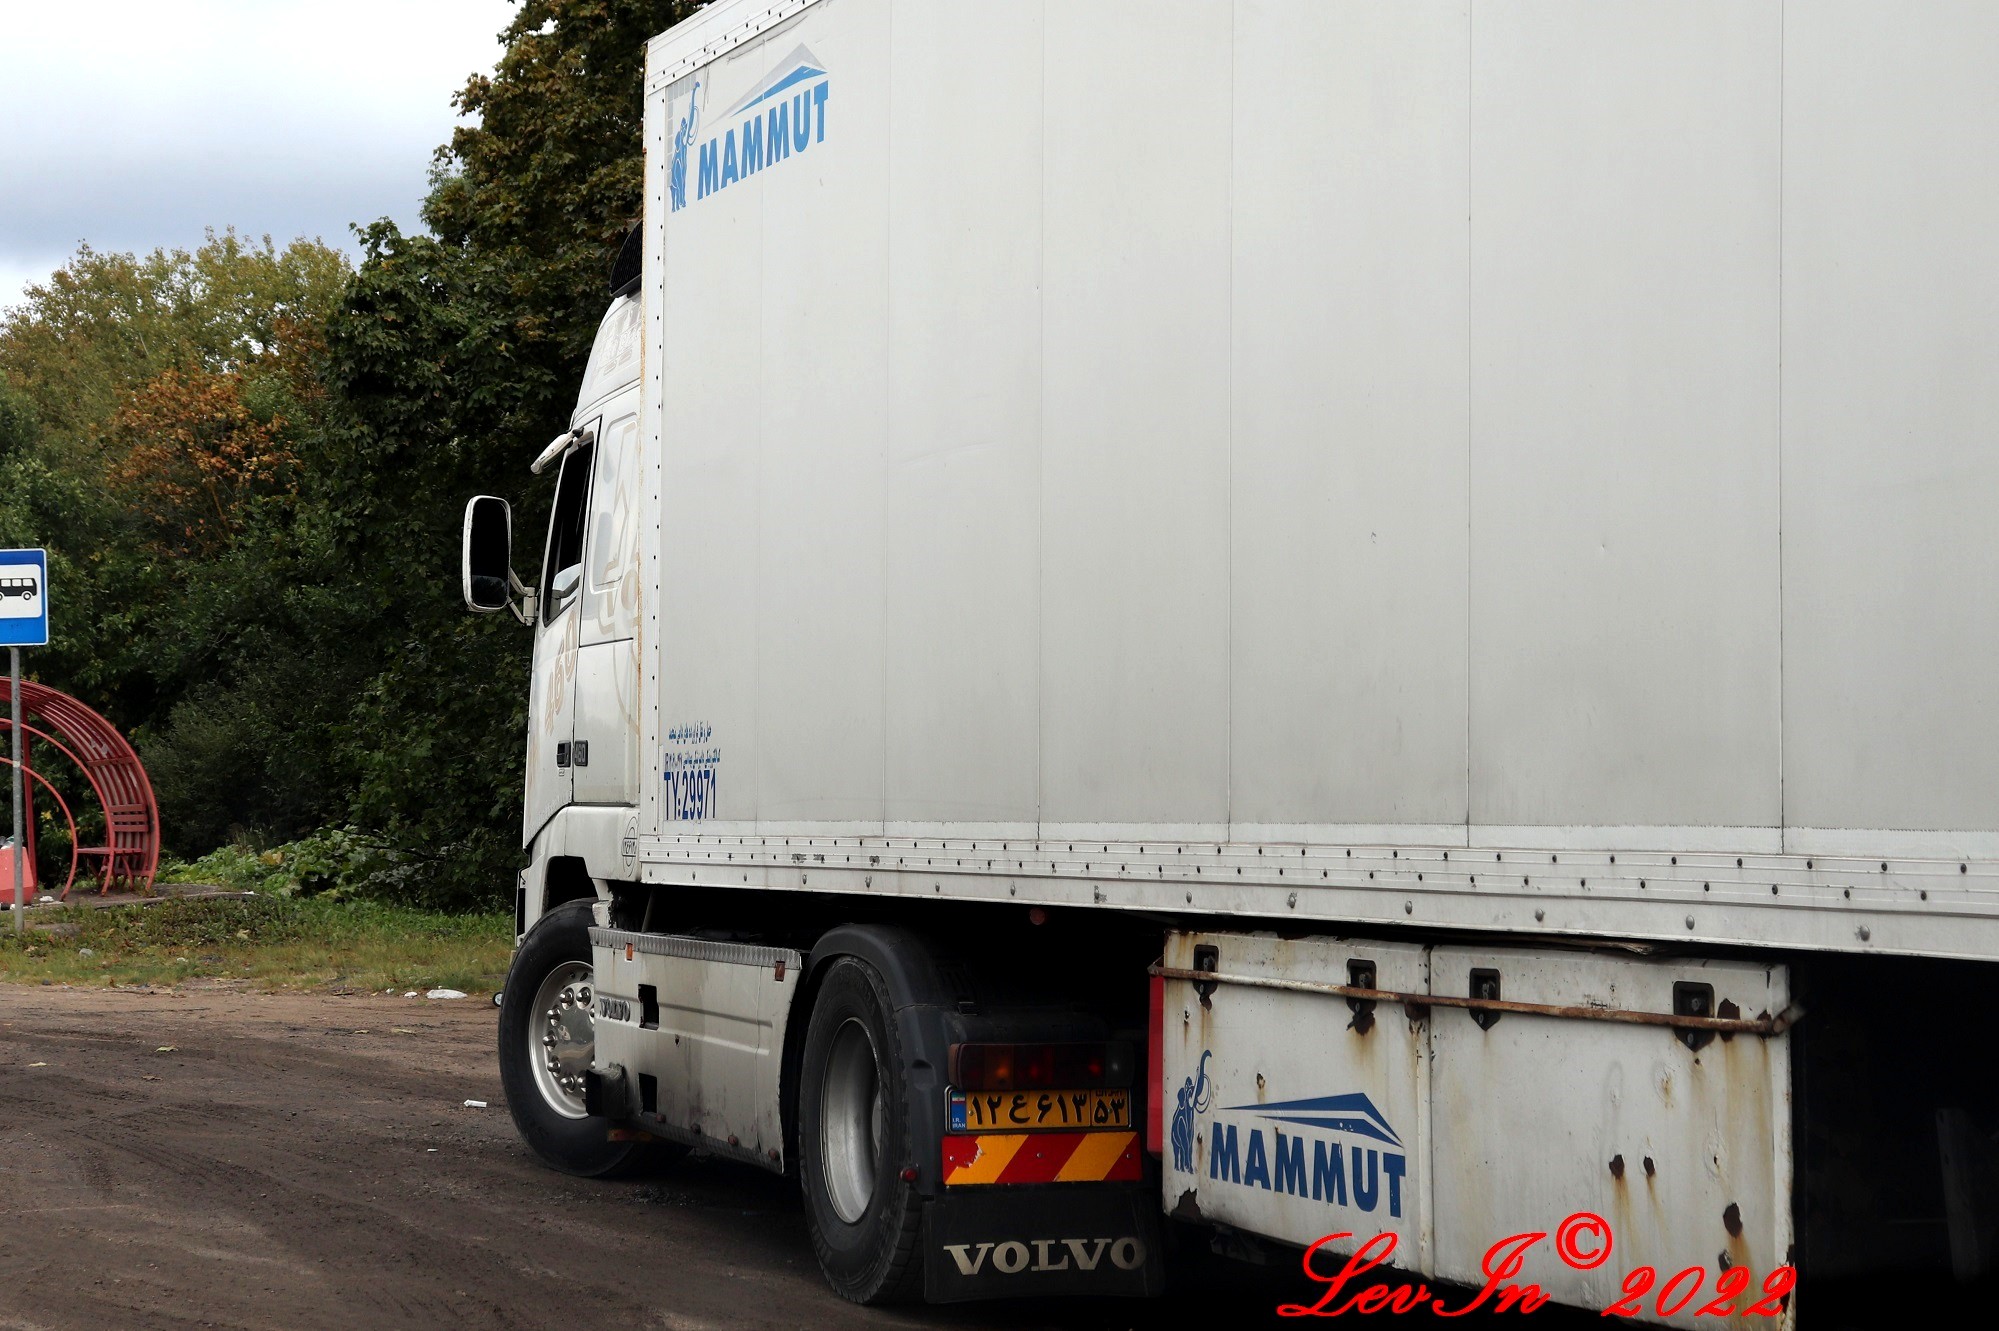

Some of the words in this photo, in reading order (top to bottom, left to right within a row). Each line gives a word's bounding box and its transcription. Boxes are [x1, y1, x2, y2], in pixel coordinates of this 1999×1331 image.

[697, 80, 829, 201] MAMMUT
[664, 768, 716, 821] TY:29971
[1210, 1122, 1406, 1218] MAMMUT
[943, 1236, 1148, 1276] VOLVO
